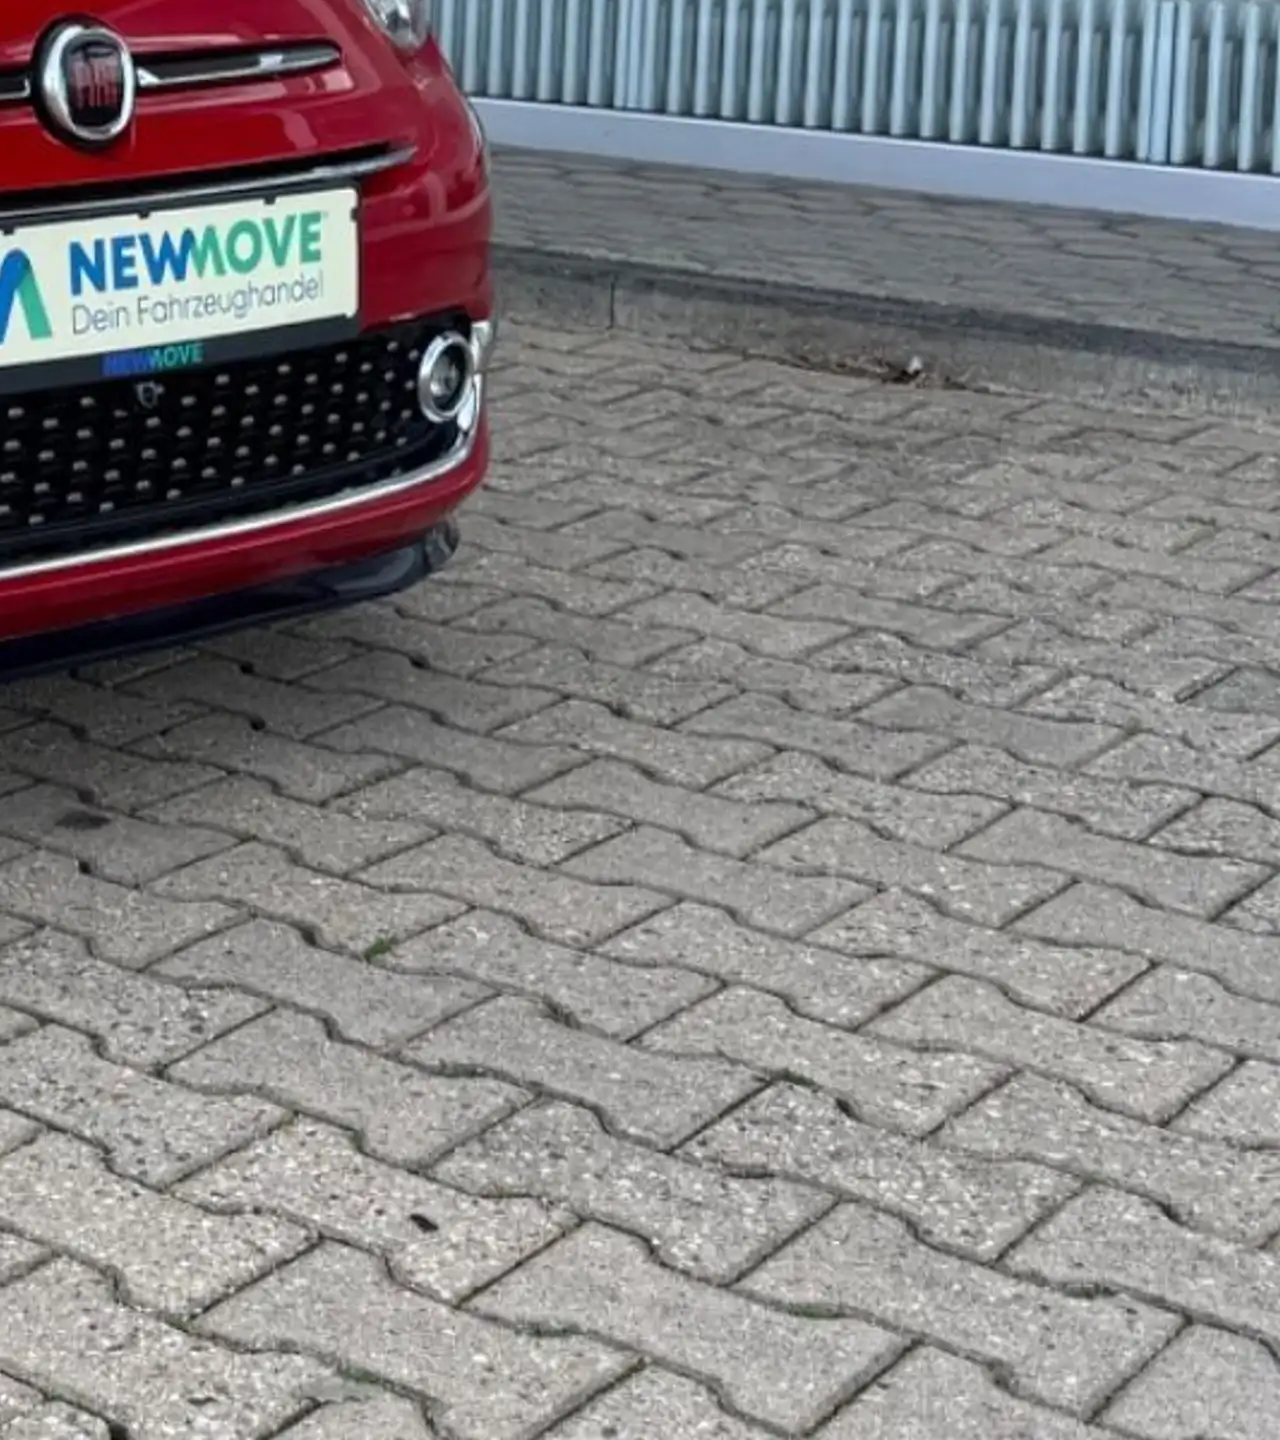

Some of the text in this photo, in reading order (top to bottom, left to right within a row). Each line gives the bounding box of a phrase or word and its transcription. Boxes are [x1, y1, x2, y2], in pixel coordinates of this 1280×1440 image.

[68, 211, 322, 296] NEWMOVE
[72, 269, 325, 335] Dein Fahrzeughandel
